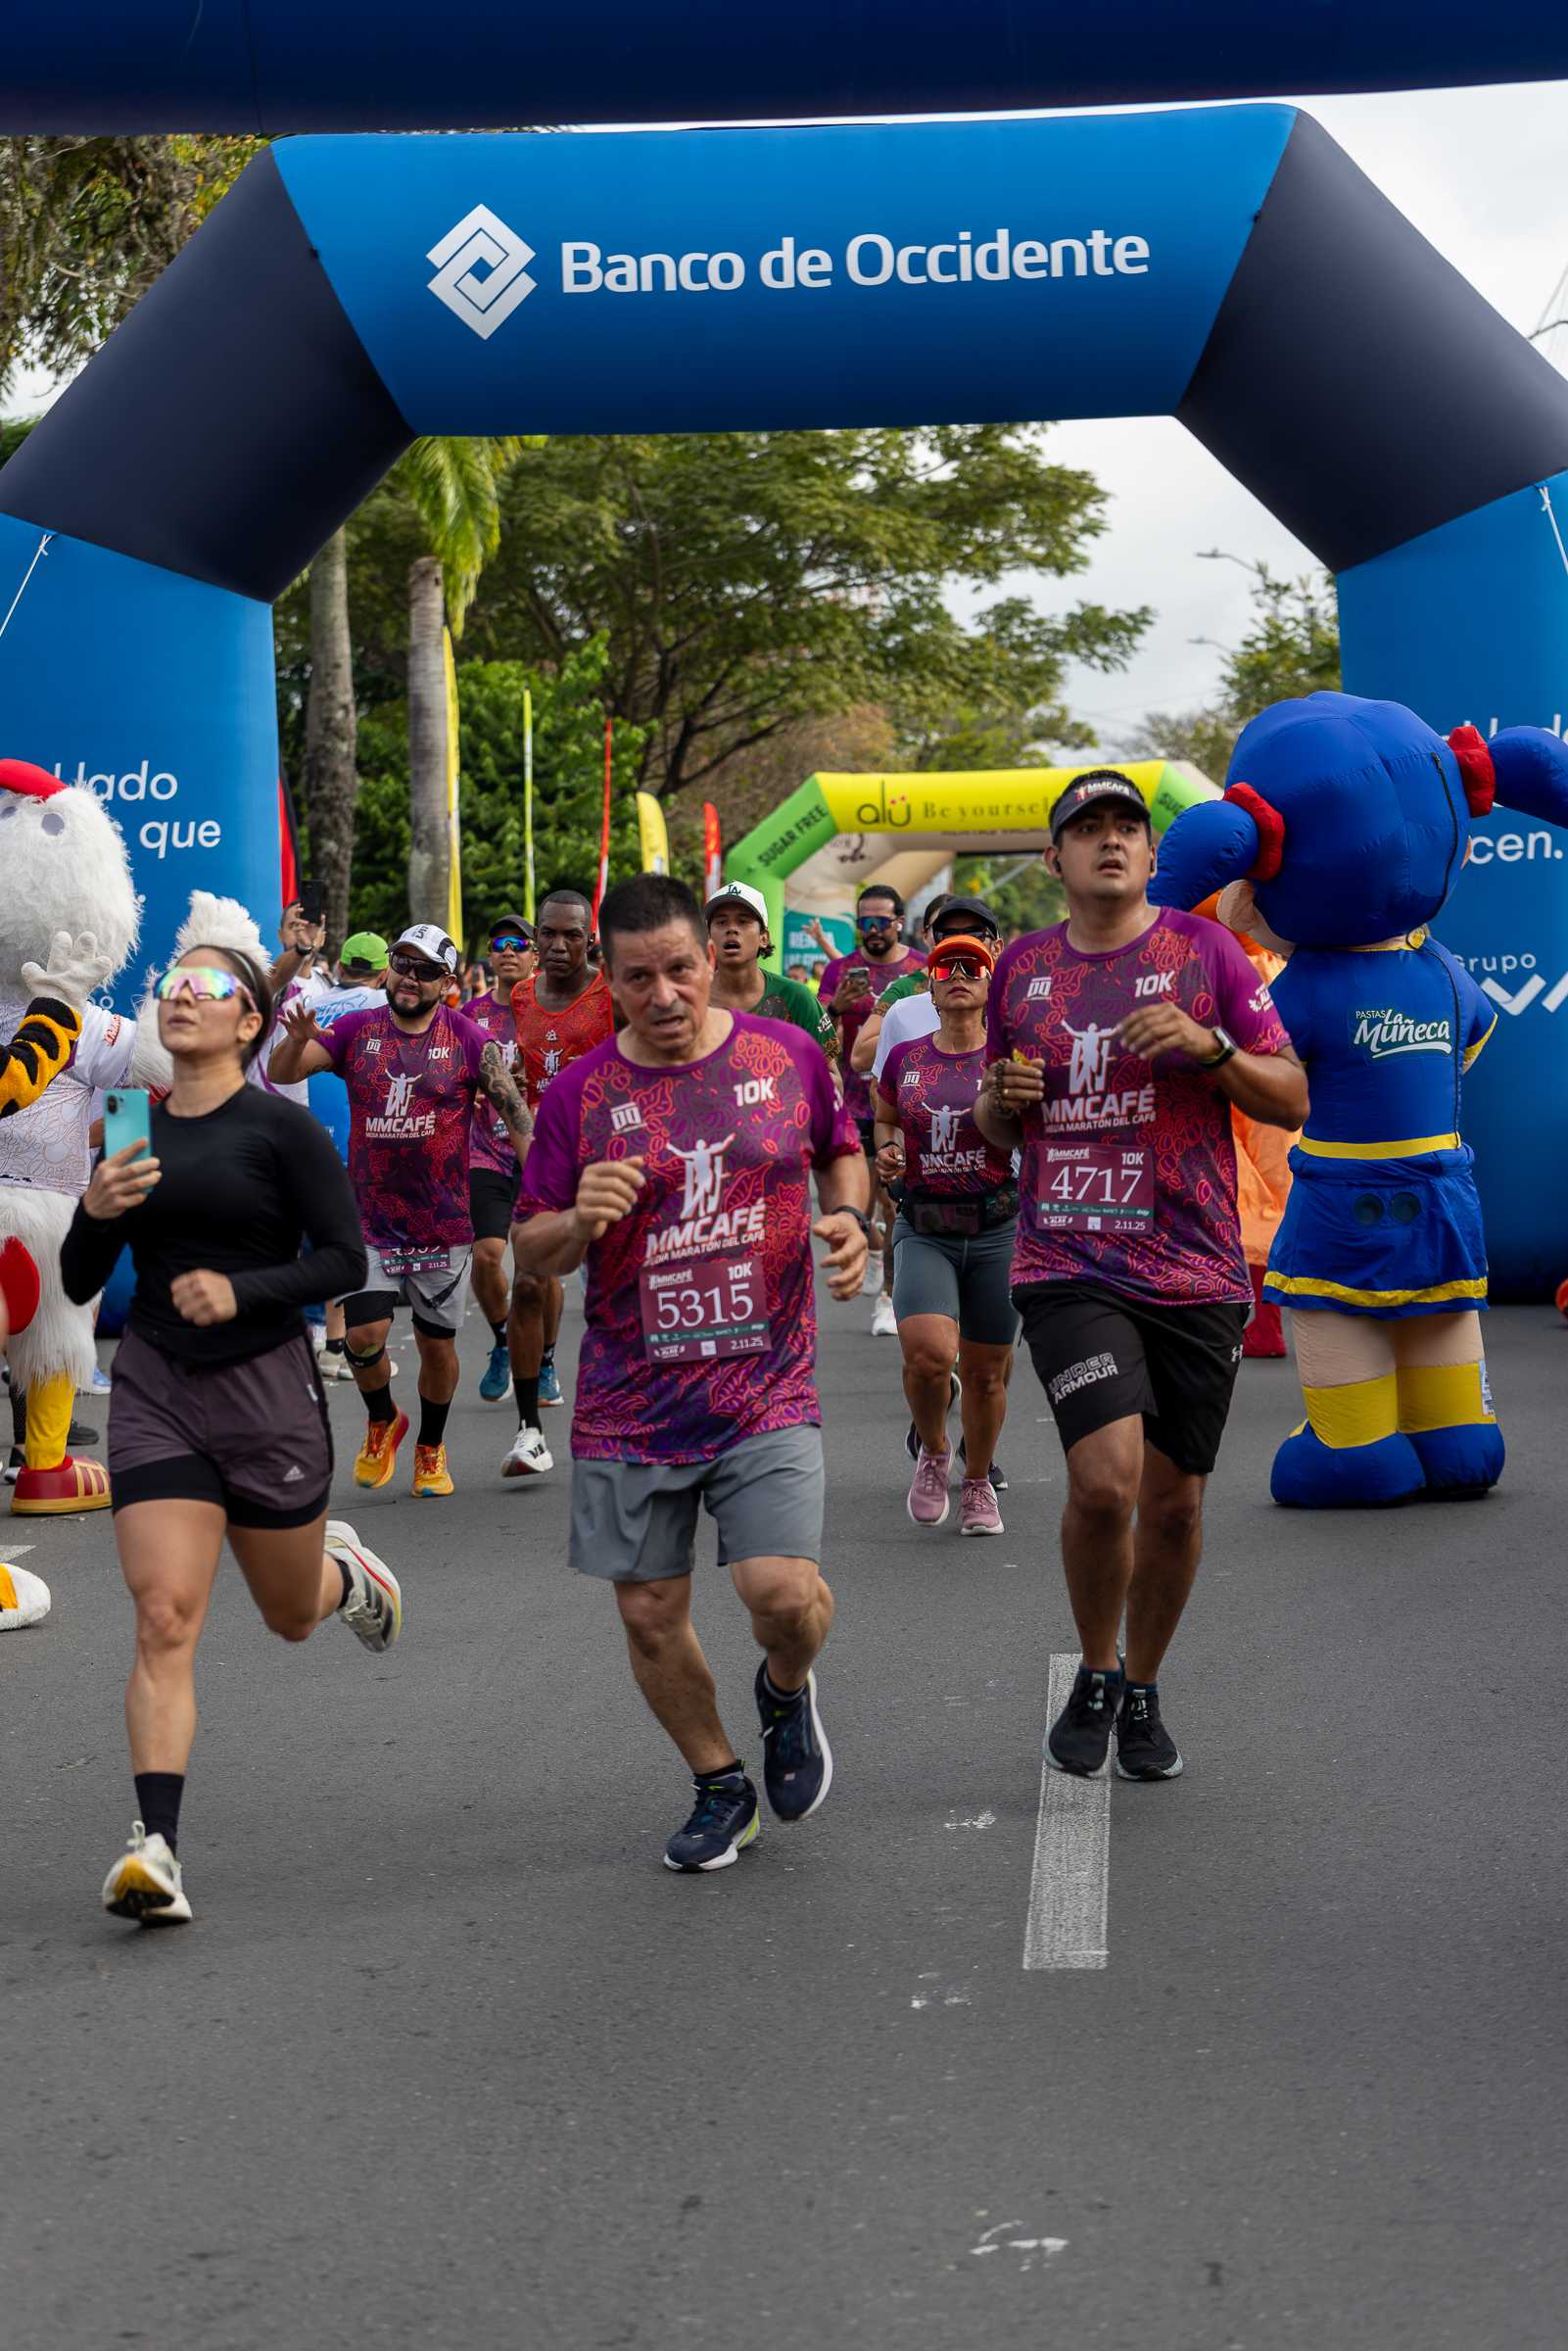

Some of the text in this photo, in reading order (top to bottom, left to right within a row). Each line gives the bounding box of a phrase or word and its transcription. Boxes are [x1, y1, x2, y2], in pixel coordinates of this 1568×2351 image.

[561, 228, 1151, 294] Banco de Occidente
[959, 796, 1049, 822] yoursel
[139, 820, 221, 859] que
[757, 828, 799, 868] SUGAR
[794, 803, 830, 836] FREE
[1134, 970, 1175, 997] 10K
[1355, 1009, 1403, 1025] PASTAS La
[1354, 1019, 1450, 1053] Muñeca
[428, 1047, 451, 1060] 10K
[733, 1076, 776, 1107] 10K
[1040, 1082, 1156, 1124] MMCAFÉ
[365, 1111, 436, 1132] MMCAFÉ
[1113, 1117, 1130, 1127] DEL
[1121, 1152, 1144, 1165] 10K
[1050, 1166, 1143, 1203] 4717
[645, 1197, 767, 1261] MMCAFÉ
[728, 1261, 752, 1280] 10K
[657, 1282, 754, 1329] 5315
[1050, 1352, 1115, 1394] UNDER
[1055, 1365, 1118, 1405] ARMOUR
